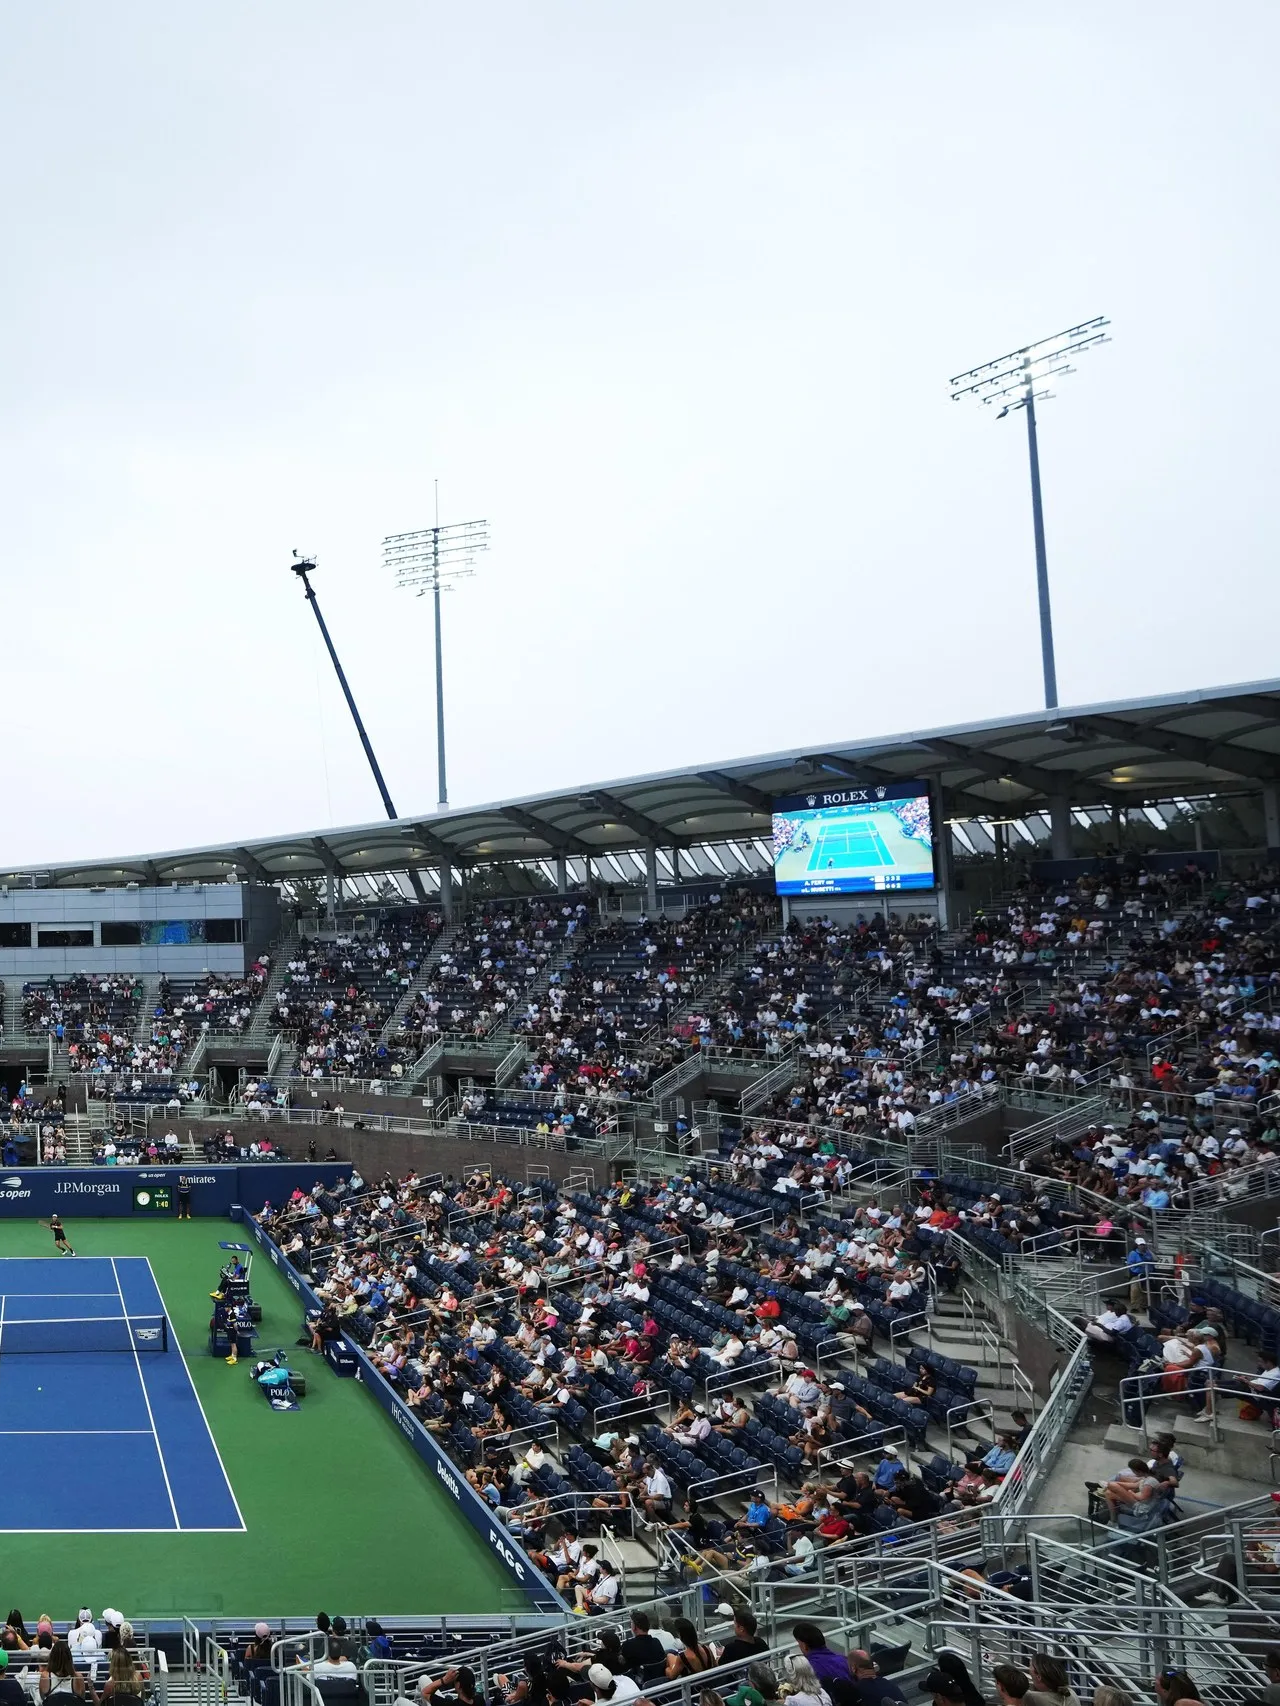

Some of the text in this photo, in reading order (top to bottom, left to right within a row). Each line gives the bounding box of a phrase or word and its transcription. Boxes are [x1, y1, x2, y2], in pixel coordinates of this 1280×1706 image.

[823, 790, 868, 804] ROLEX
[6, 1190, 31, 1200] open
[54, 1182, 120, 1196] J.P.Morgan
[270, 1388, 290, 1396] POLO
[392, 1401, 402, 1424] IHG
[490, 1528, 524, 1580] FAGE
